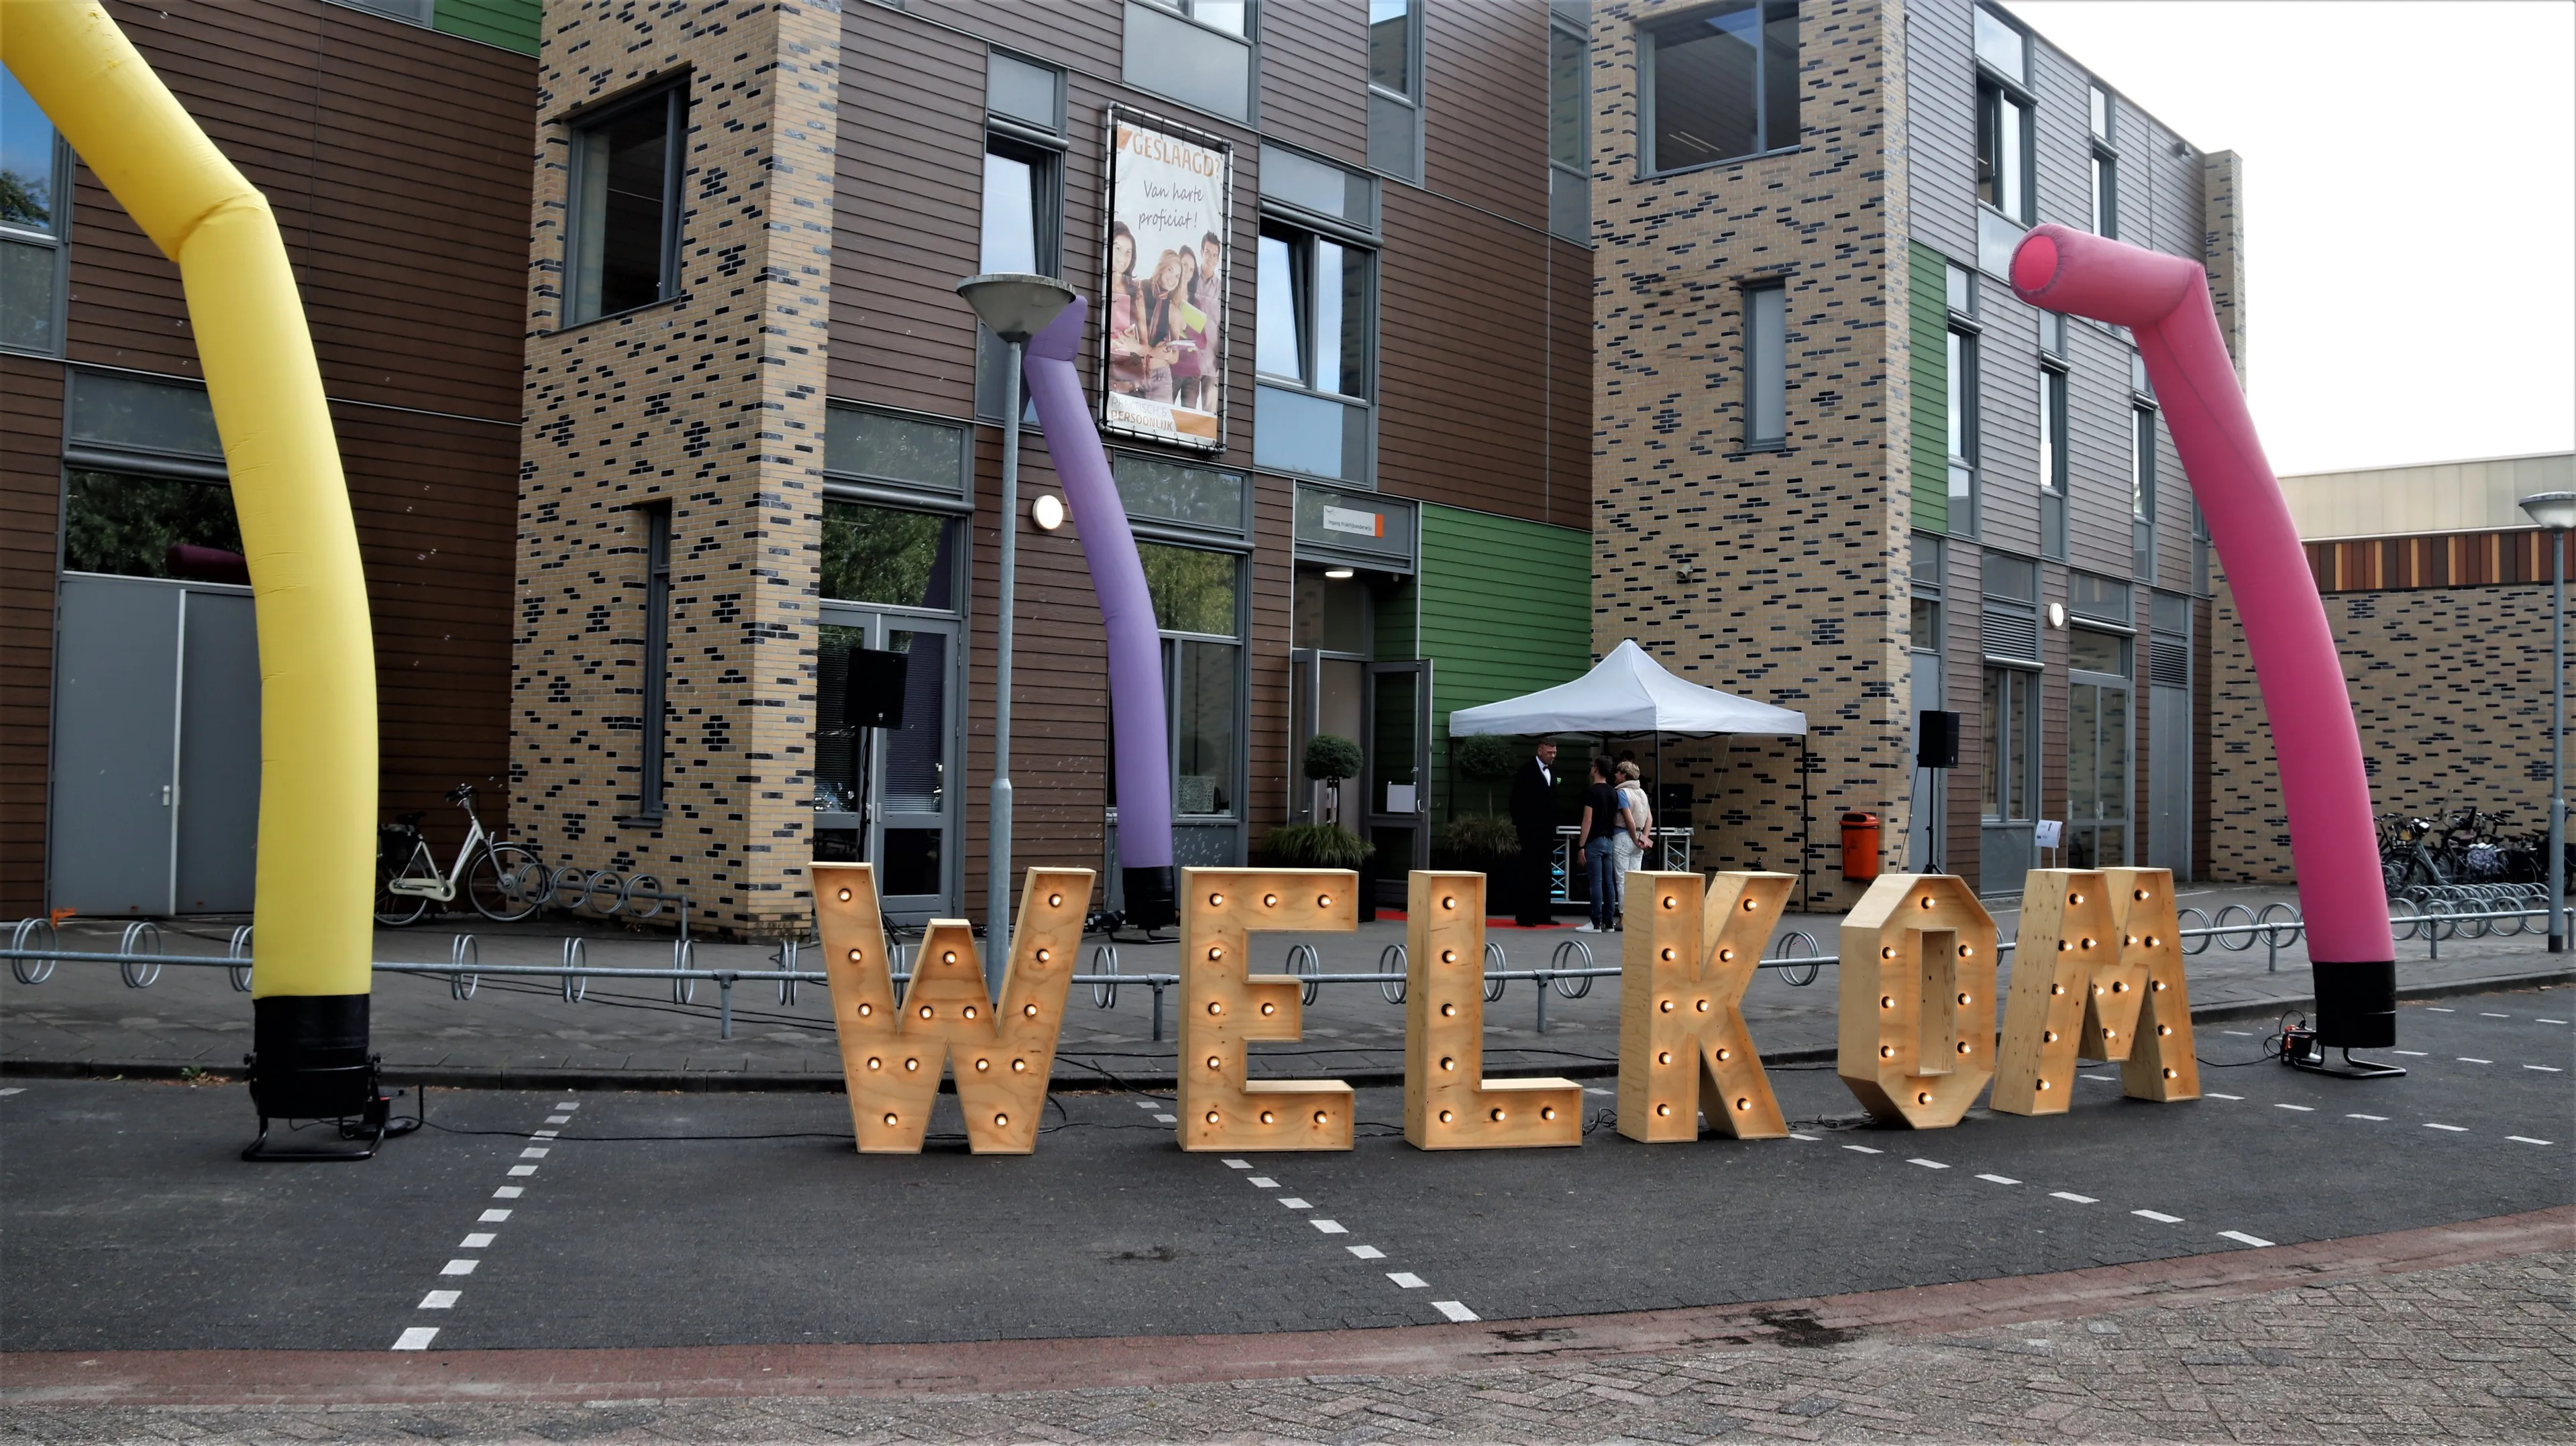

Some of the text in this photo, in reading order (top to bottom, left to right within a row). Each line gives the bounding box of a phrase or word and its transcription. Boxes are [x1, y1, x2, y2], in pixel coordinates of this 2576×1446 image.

[1132, 133, 1221, 180] GESLAAGD?
[1143, 180, 1204, 203] Van harte
[1110, 410, 1173, 431] PERSOONLIJK
[808, 861, 2202, 1156] WELKOM
